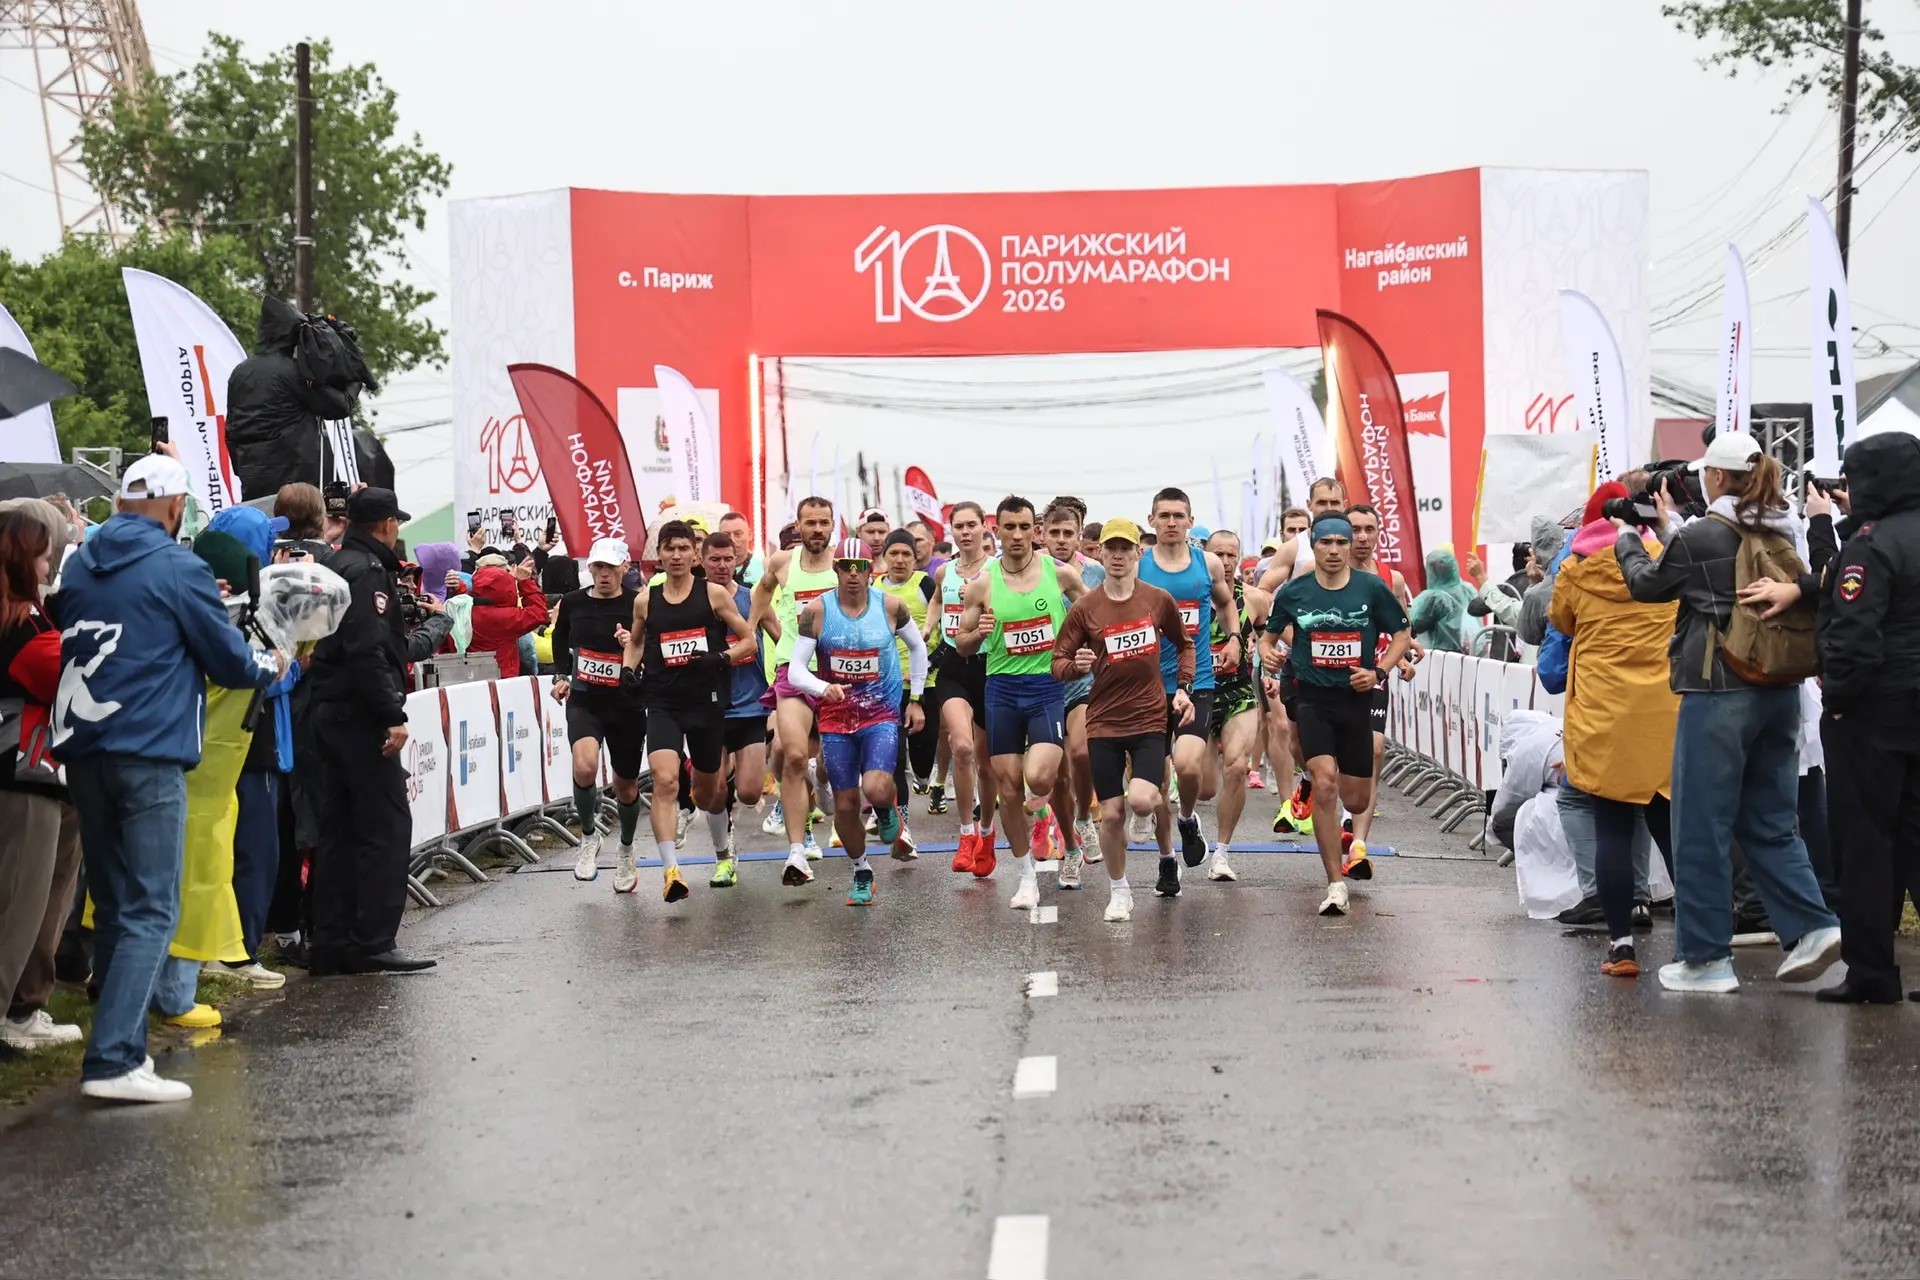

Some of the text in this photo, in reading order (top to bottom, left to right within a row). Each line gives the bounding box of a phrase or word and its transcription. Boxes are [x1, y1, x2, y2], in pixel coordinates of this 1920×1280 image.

[1001, 227, 1186, 258] ПАРИЖСКИЙ
[1345, 235, 1468, 269] Нагайбакский
[618, 266, 714, 293] с. Париж
[1001, 257, 1230, 285] ПОЛУМАРАФОН
[1378, 263, 1431, 291] район
[1002, 289, 1066, 313] 2026
[1012, 629, 1045, 645] 7051
[1113, 631, 1147, 650] 7597
[669, 640, 698, 656] 7122
[1319, 644, 1352, 656] 7281
[583, 659, 614, 676] 7346
[837, 659, 871, 672] 7634
